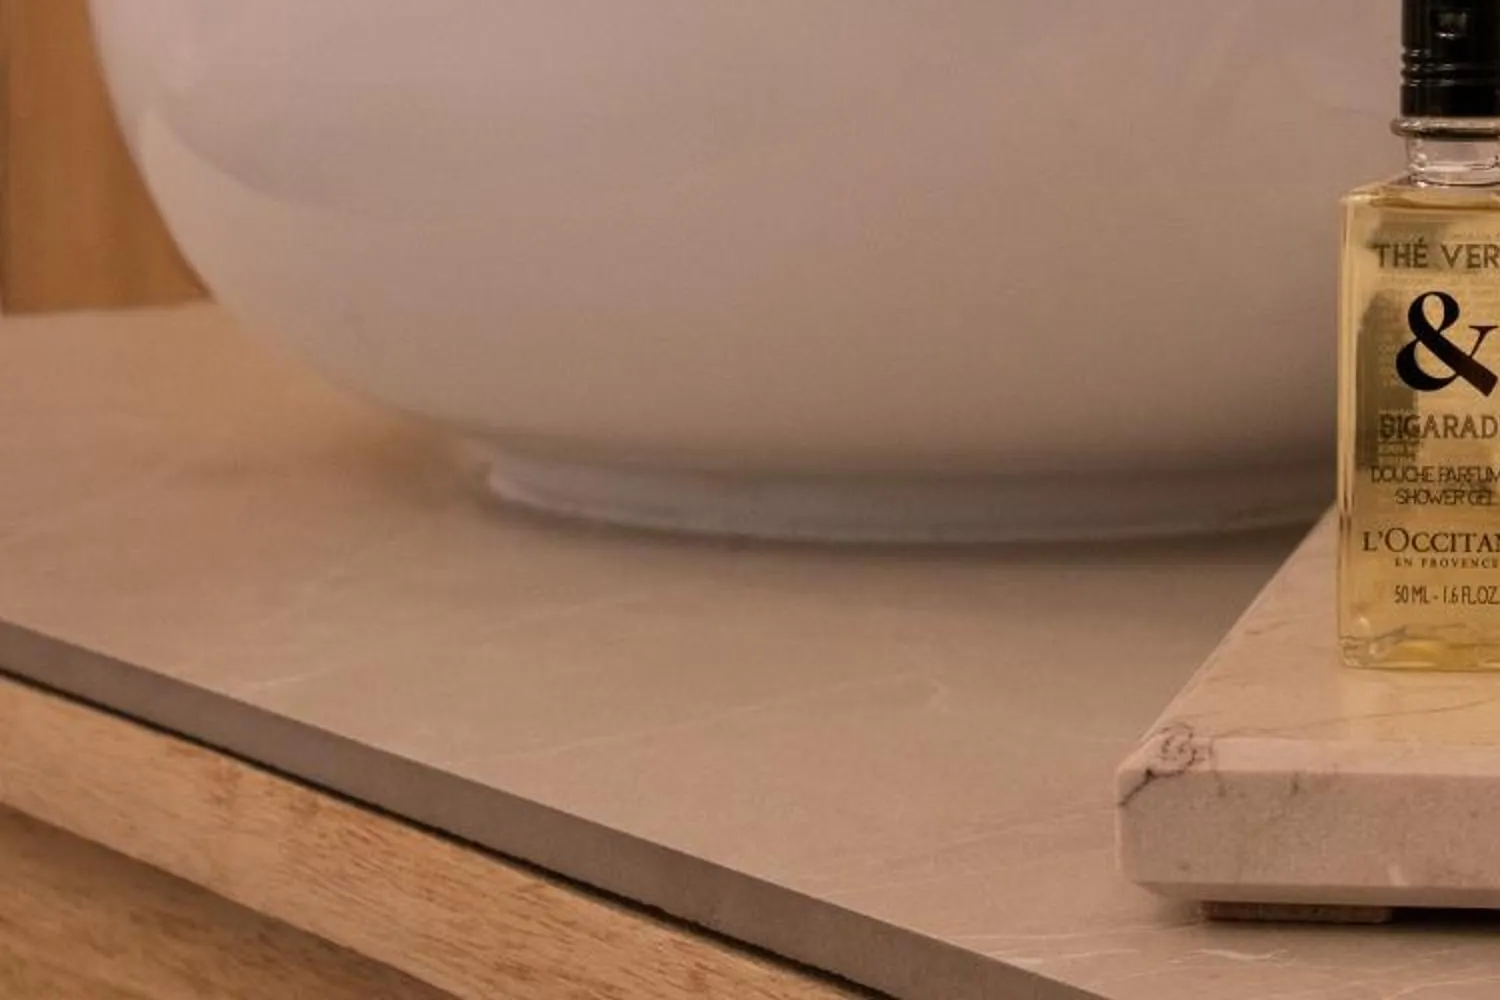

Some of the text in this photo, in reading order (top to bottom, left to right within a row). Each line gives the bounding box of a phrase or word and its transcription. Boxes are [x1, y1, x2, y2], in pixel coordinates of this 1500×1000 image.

[1373, 236, 1428, 269] THÉ
[1396, 290, 1499, 397] &
[1371, 465, 1435, 483] DOUCHE
[1394, 488, 1465, 505] SHOWER
[1421, 557, 1499, 569] PROVENCE
[1394, 584, 1408, 604] 50
[1412, 585, 1430, 604] ML
